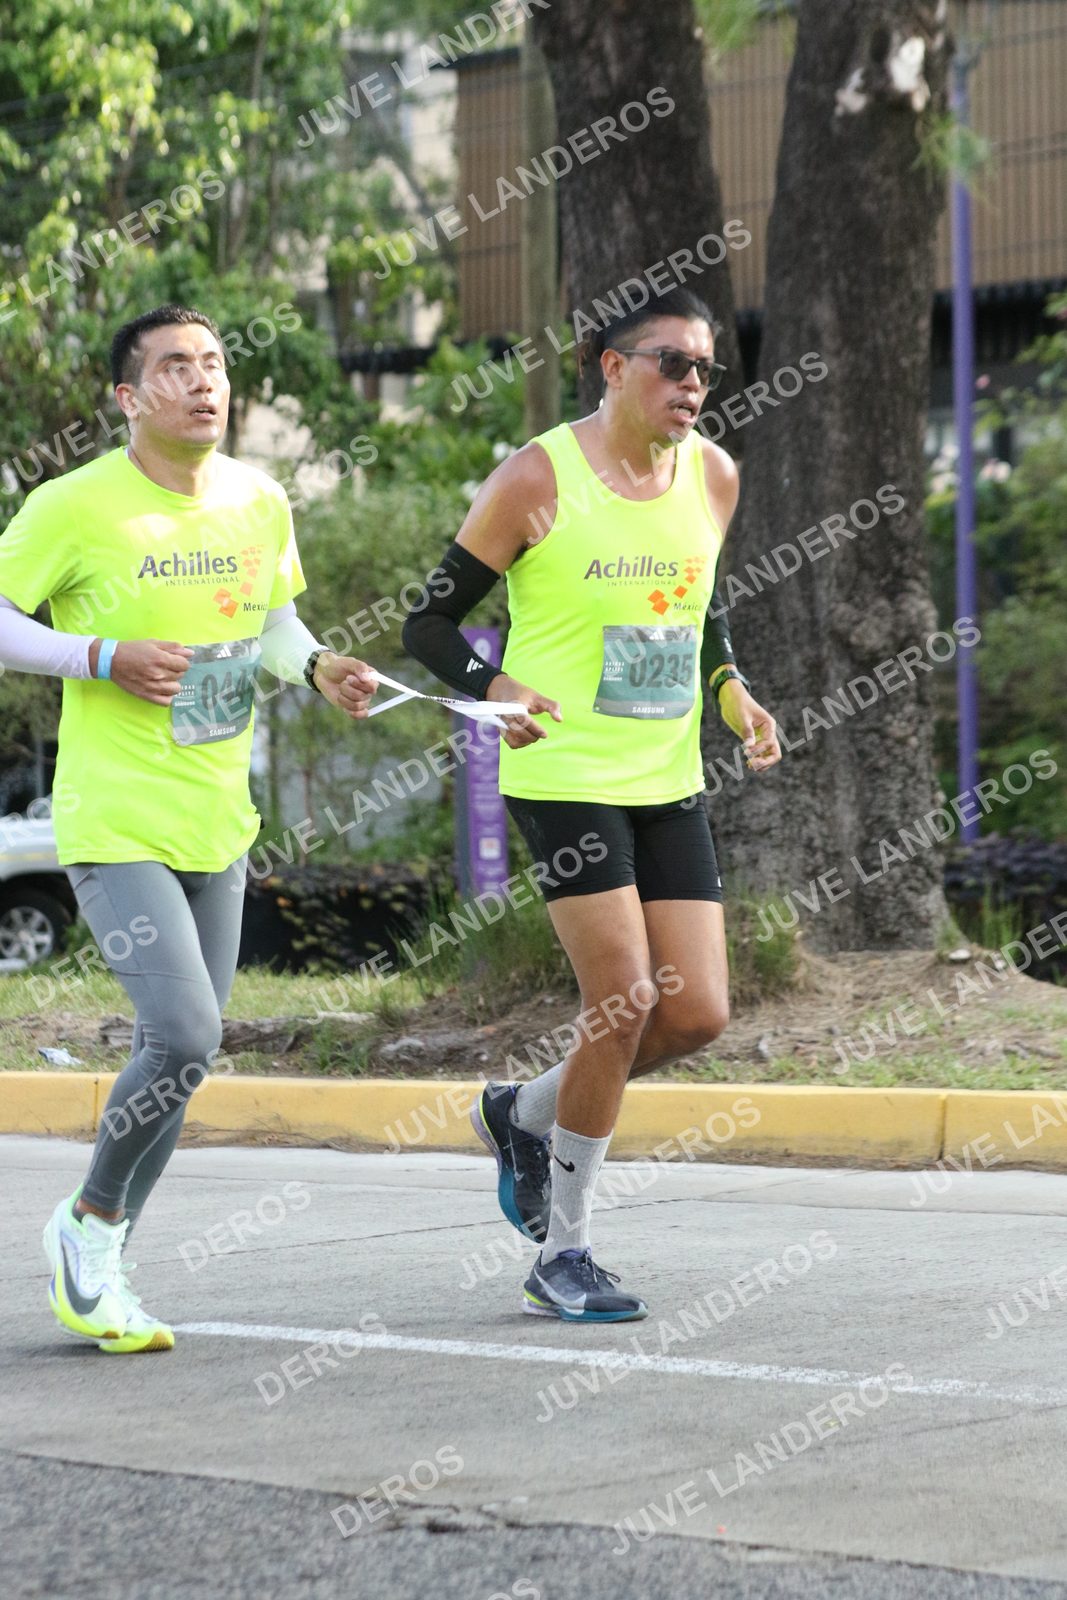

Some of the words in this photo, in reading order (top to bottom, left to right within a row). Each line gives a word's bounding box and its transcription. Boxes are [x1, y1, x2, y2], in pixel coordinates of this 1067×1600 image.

[137, 550, 239, 579] Achilles
[583, 555, 679, 580] Achilles
[166, 577, 240, 587] INTERNATIONAL
[607, 580, 678, 588] INTERNATIONAL
[631, 706, 665, 714] SAMSUNG
[209, 725, 236, 737] SAMSUNG
